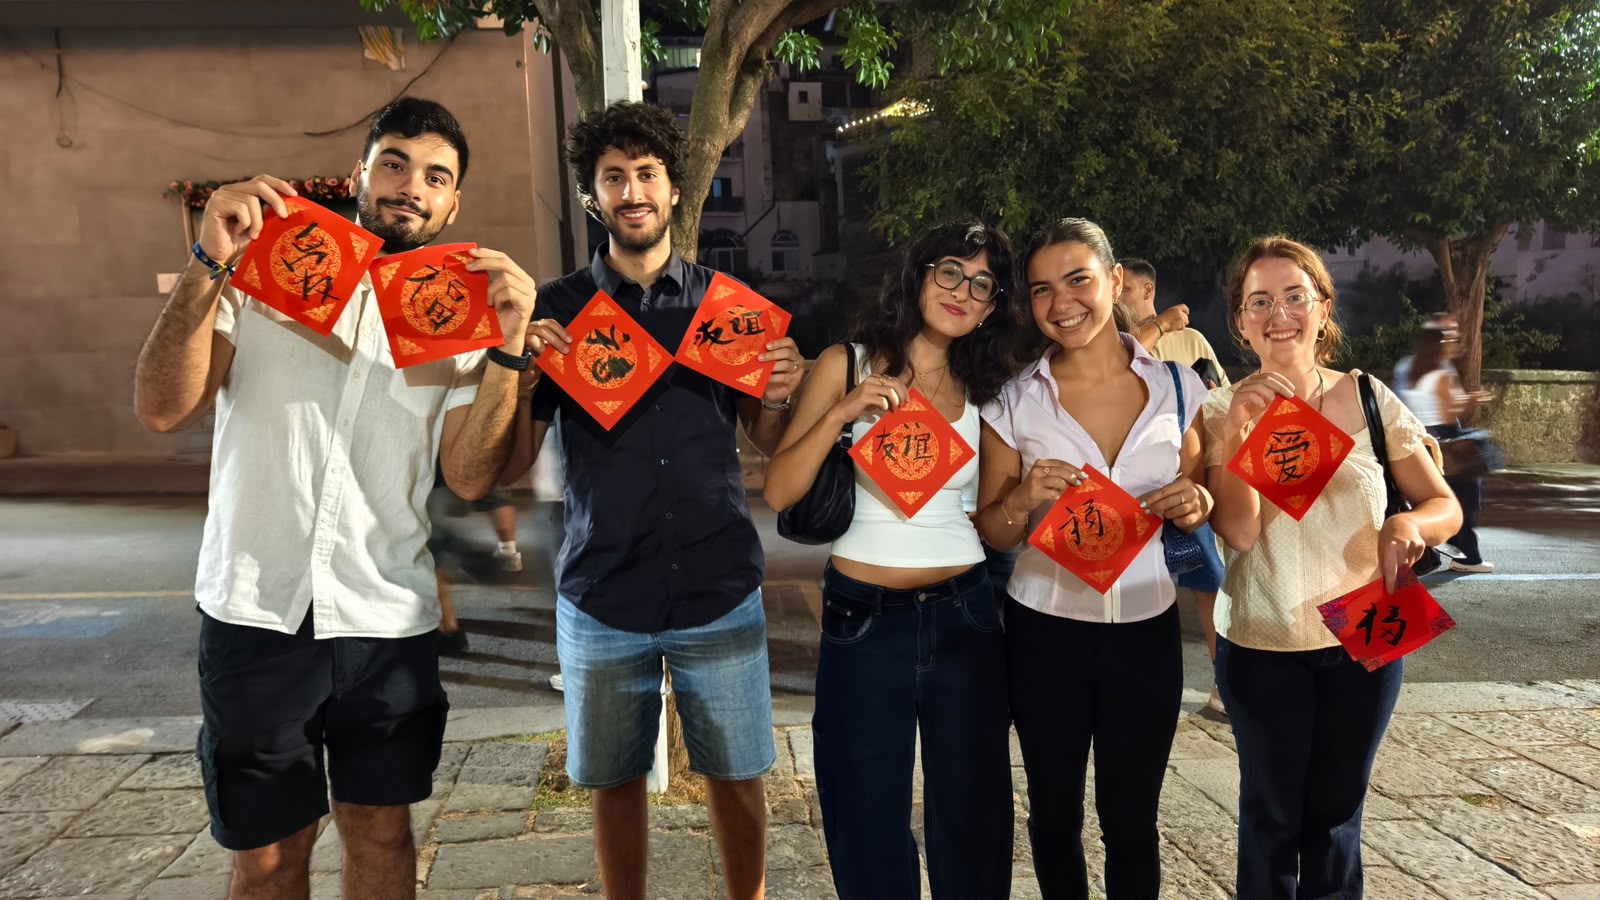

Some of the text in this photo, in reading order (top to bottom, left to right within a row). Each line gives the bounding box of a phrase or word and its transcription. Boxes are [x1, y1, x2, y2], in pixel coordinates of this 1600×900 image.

[404, 264, 472, 333] 福
[693, 304, 766, 350] 友谊
[875, 422, 934, 462] 友谊
[1265, 430, 1310, 484] 爱
